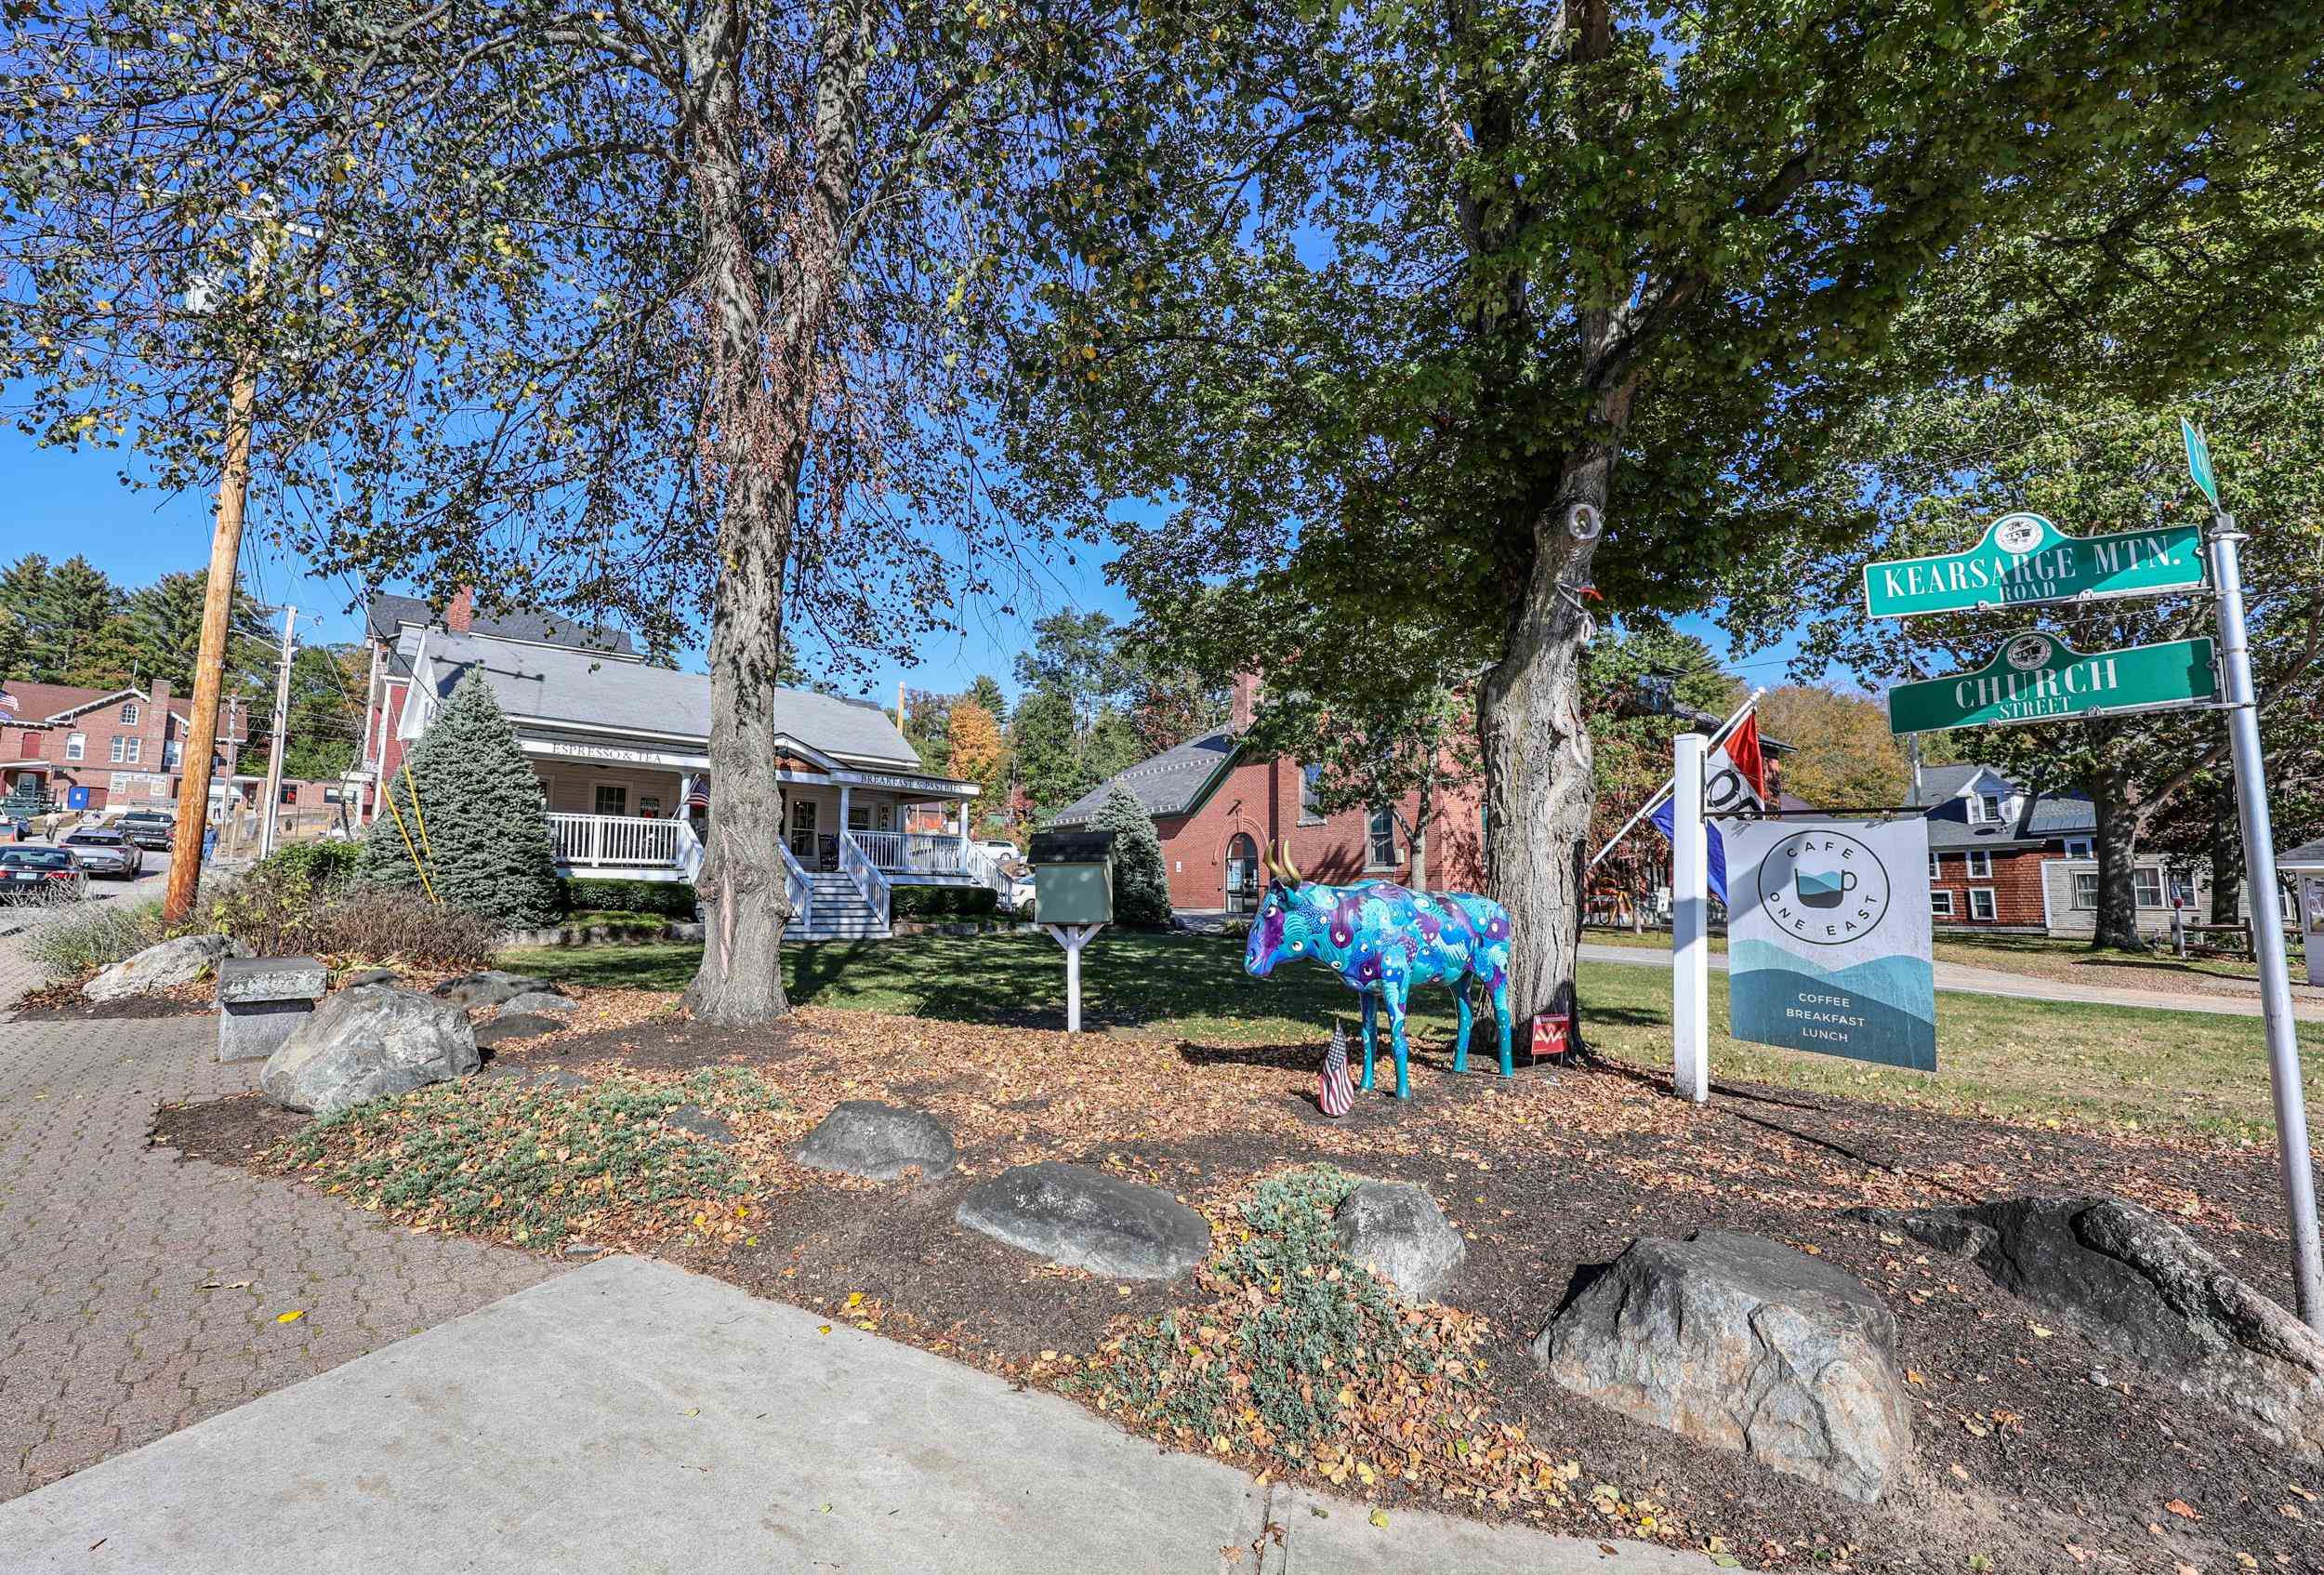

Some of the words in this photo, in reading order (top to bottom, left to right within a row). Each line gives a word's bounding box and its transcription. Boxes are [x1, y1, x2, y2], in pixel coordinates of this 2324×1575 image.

[1884, 548, 2076, 598] KEARSARGE
[2093, 536, 2182, 575] MTN.
[2000, 581, 2057, 602] ROAD
[1955, 658, 2119, 709] CHURCH
[2000, 695, 2071, 720] STREET
[552, 743, 620, 759] ESPRESSO
[638, 751, 662, 765] TEA
[861, 773, 912, 789] BREAKFAST
[1787, 841, 1854, 860] CAFE
[1769, 892, 1805, 931] ONE
[1826, 894, 1877, 936] EAST
[1798, 992, 1851, 1008] COFFEE
[1786, 1008, 1866, 1027] BREAKFAST
[1802, 1026, 1849, 1042] LUNCH
